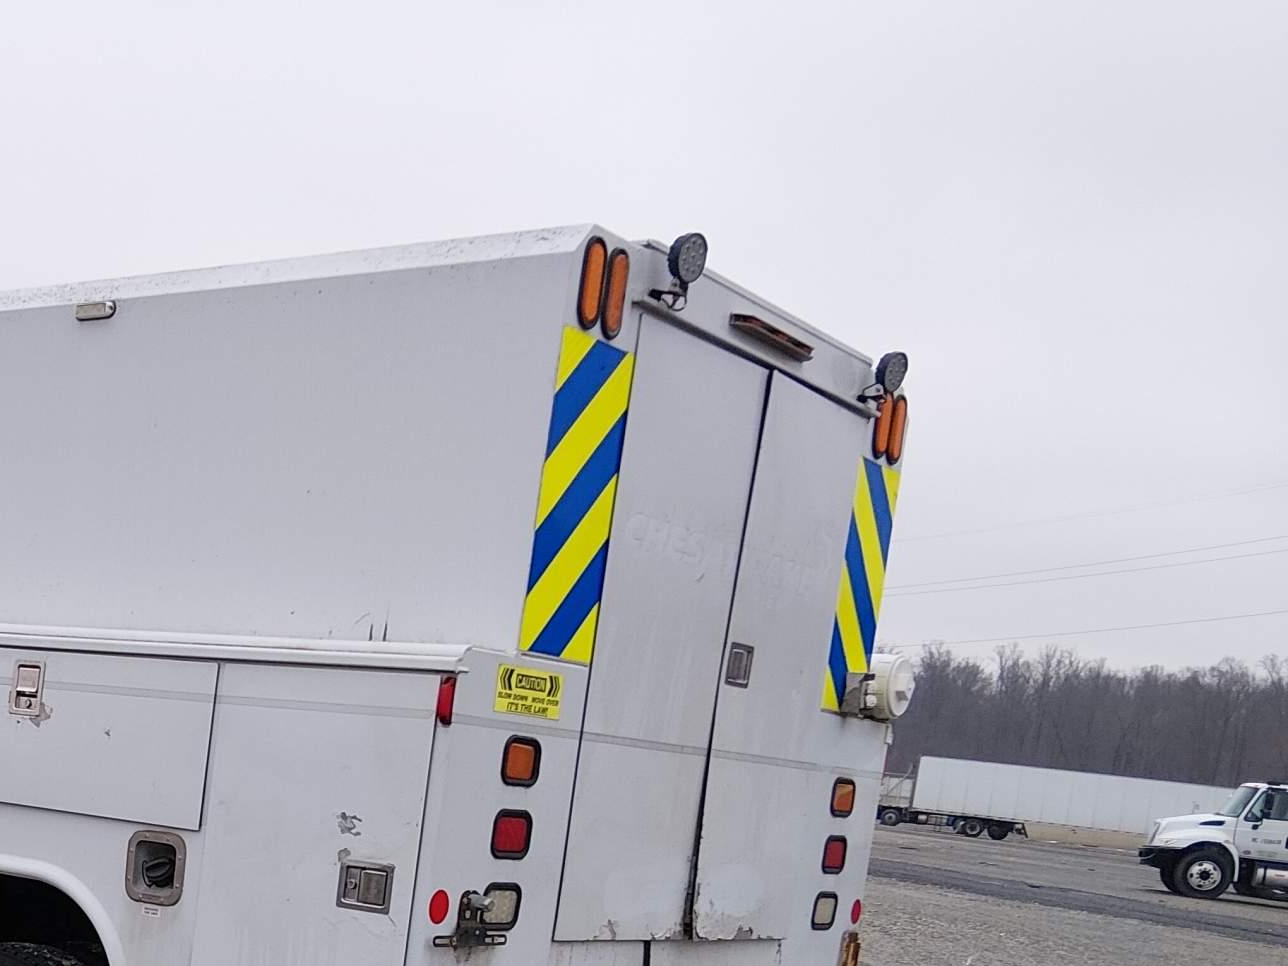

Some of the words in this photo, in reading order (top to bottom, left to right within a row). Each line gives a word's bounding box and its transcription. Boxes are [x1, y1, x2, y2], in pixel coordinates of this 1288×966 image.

[517, 675, 546, 691] CAUTION
[512, 693, 529, 702] DOWN
[546, 698, 559, 707] OVER
[520, 703, 533, 713] THE
